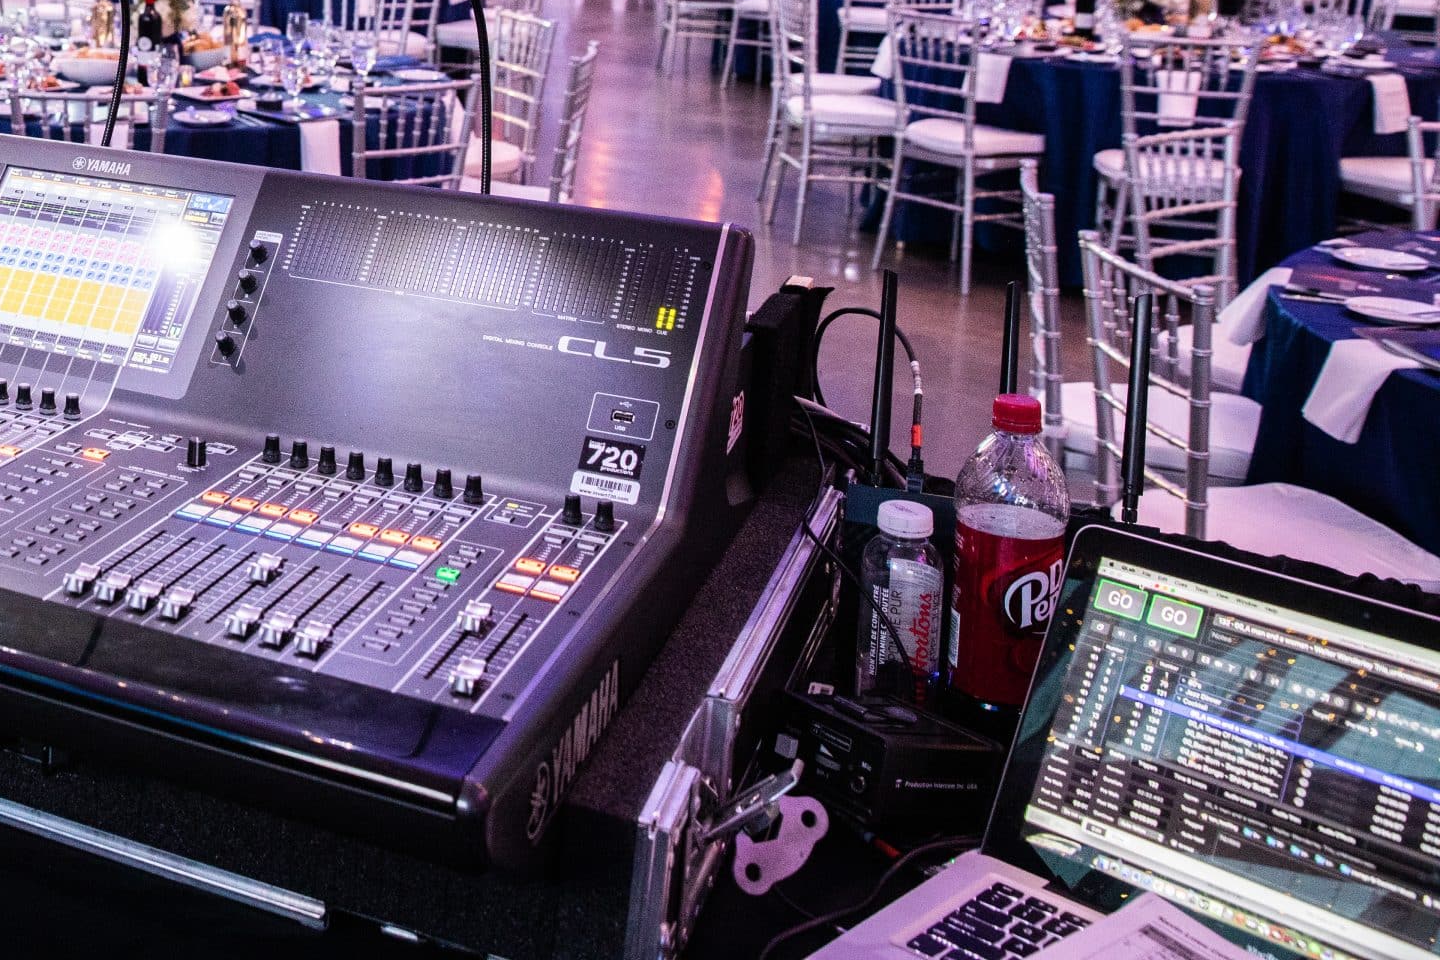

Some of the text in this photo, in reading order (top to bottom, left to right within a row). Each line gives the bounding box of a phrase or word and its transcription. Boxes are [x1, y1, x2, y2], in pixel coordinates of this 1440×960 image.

[87, 158, 132, 176] YAMAHA
[558, 335, 672, 369] CL5
[586, 441, 639, 471] 720
[600, 466, 634, 476] productions
[890, 590, 902, 616] PUR
[1108, 590, 1133, 609] GO
[1160, 606, 1187, 626] GO
[870, 642, 878, 657] FAIT
[879, 630, 888, 665] VITAMINE
[552, 660, 619, 806] YAMAHA
